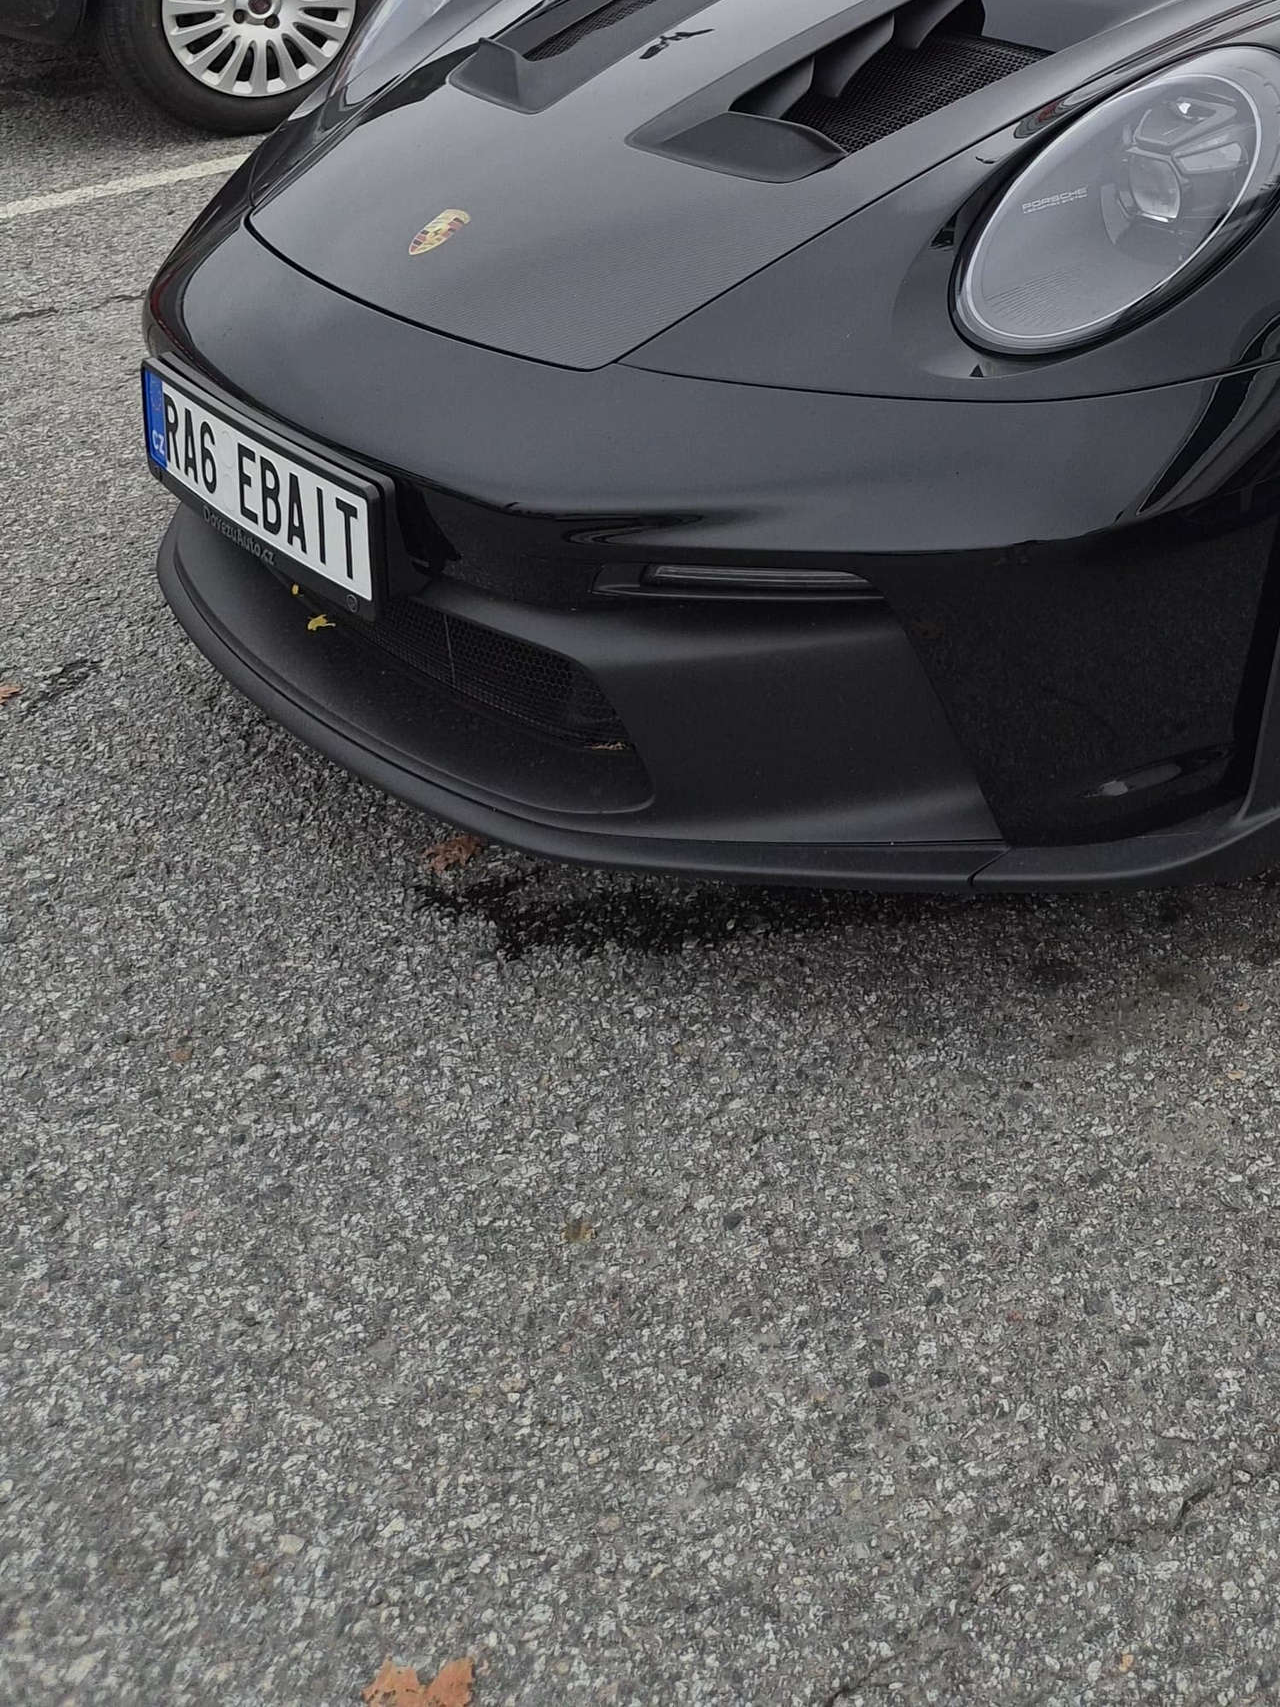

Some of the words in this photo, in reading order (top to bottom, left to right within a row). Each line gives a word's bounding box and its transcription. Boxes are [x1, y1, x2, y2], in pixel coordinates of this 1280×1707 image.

[1022, 186, 1087, 209] PORSCHE
[152, 429, 165, 455] CZ
[163, 392, 217, 494] RA6
[237, 442, 358, 580] EBAIT
[202, 505, 275, 566] DovezuAuto.cz
